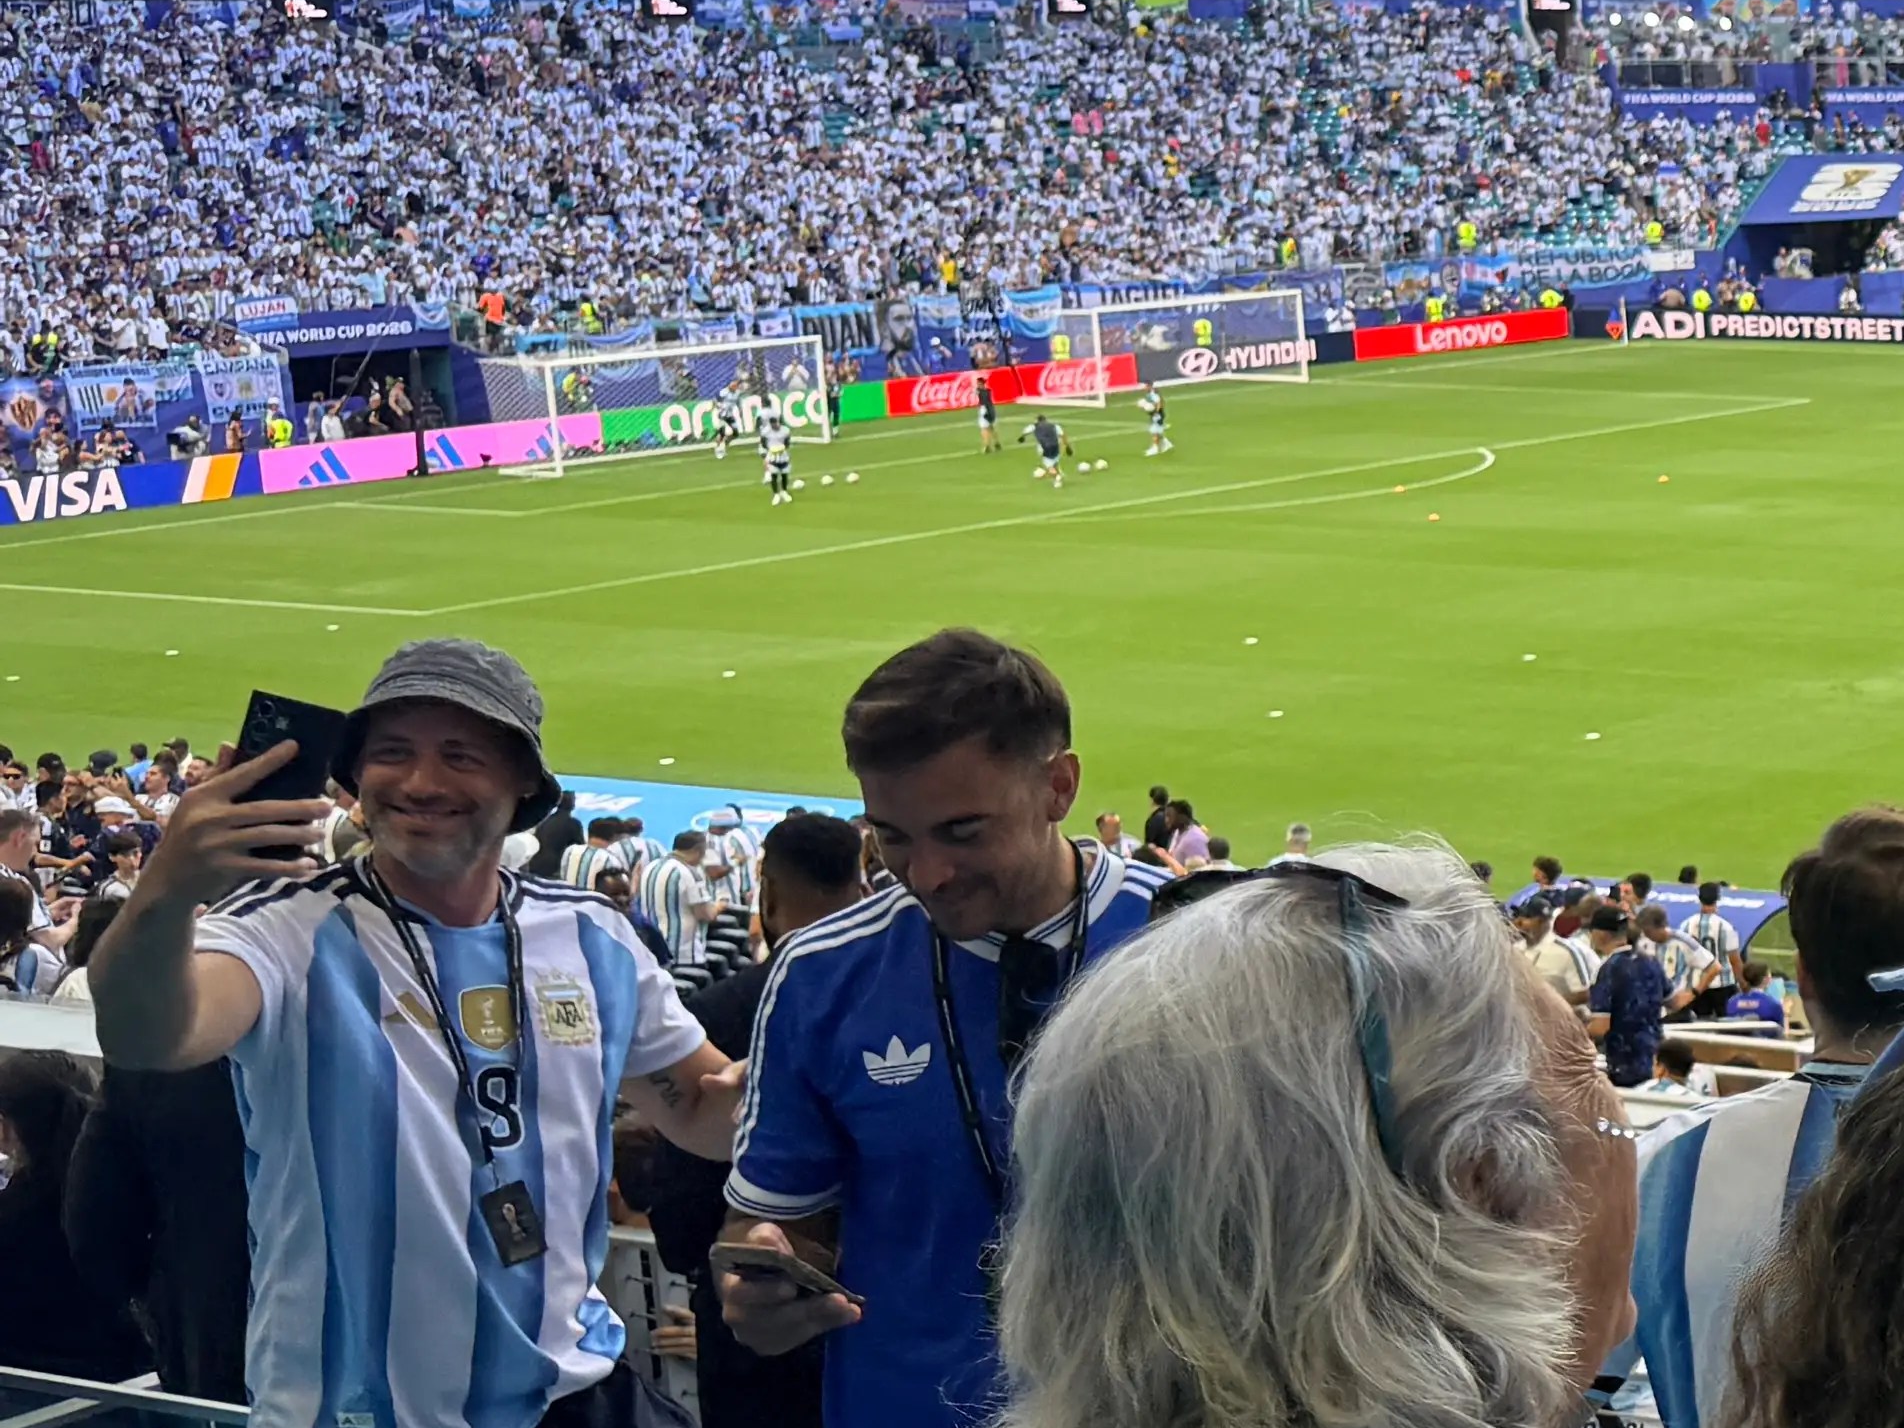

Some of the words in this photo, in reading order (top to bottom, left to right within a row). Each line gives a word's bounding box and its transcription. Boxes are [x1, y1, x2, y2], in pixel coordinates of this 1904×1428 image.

[286, 325, 336, 344] WORLD
[337, 323, 365, 340] CUP
[1415, 320, 1508, 353] Lenovo
[1632, 310, 1705, 340] ADI
[1223, 337, 1318, 371] HYUNDAI
[0, 468, 127, 522] VISA
